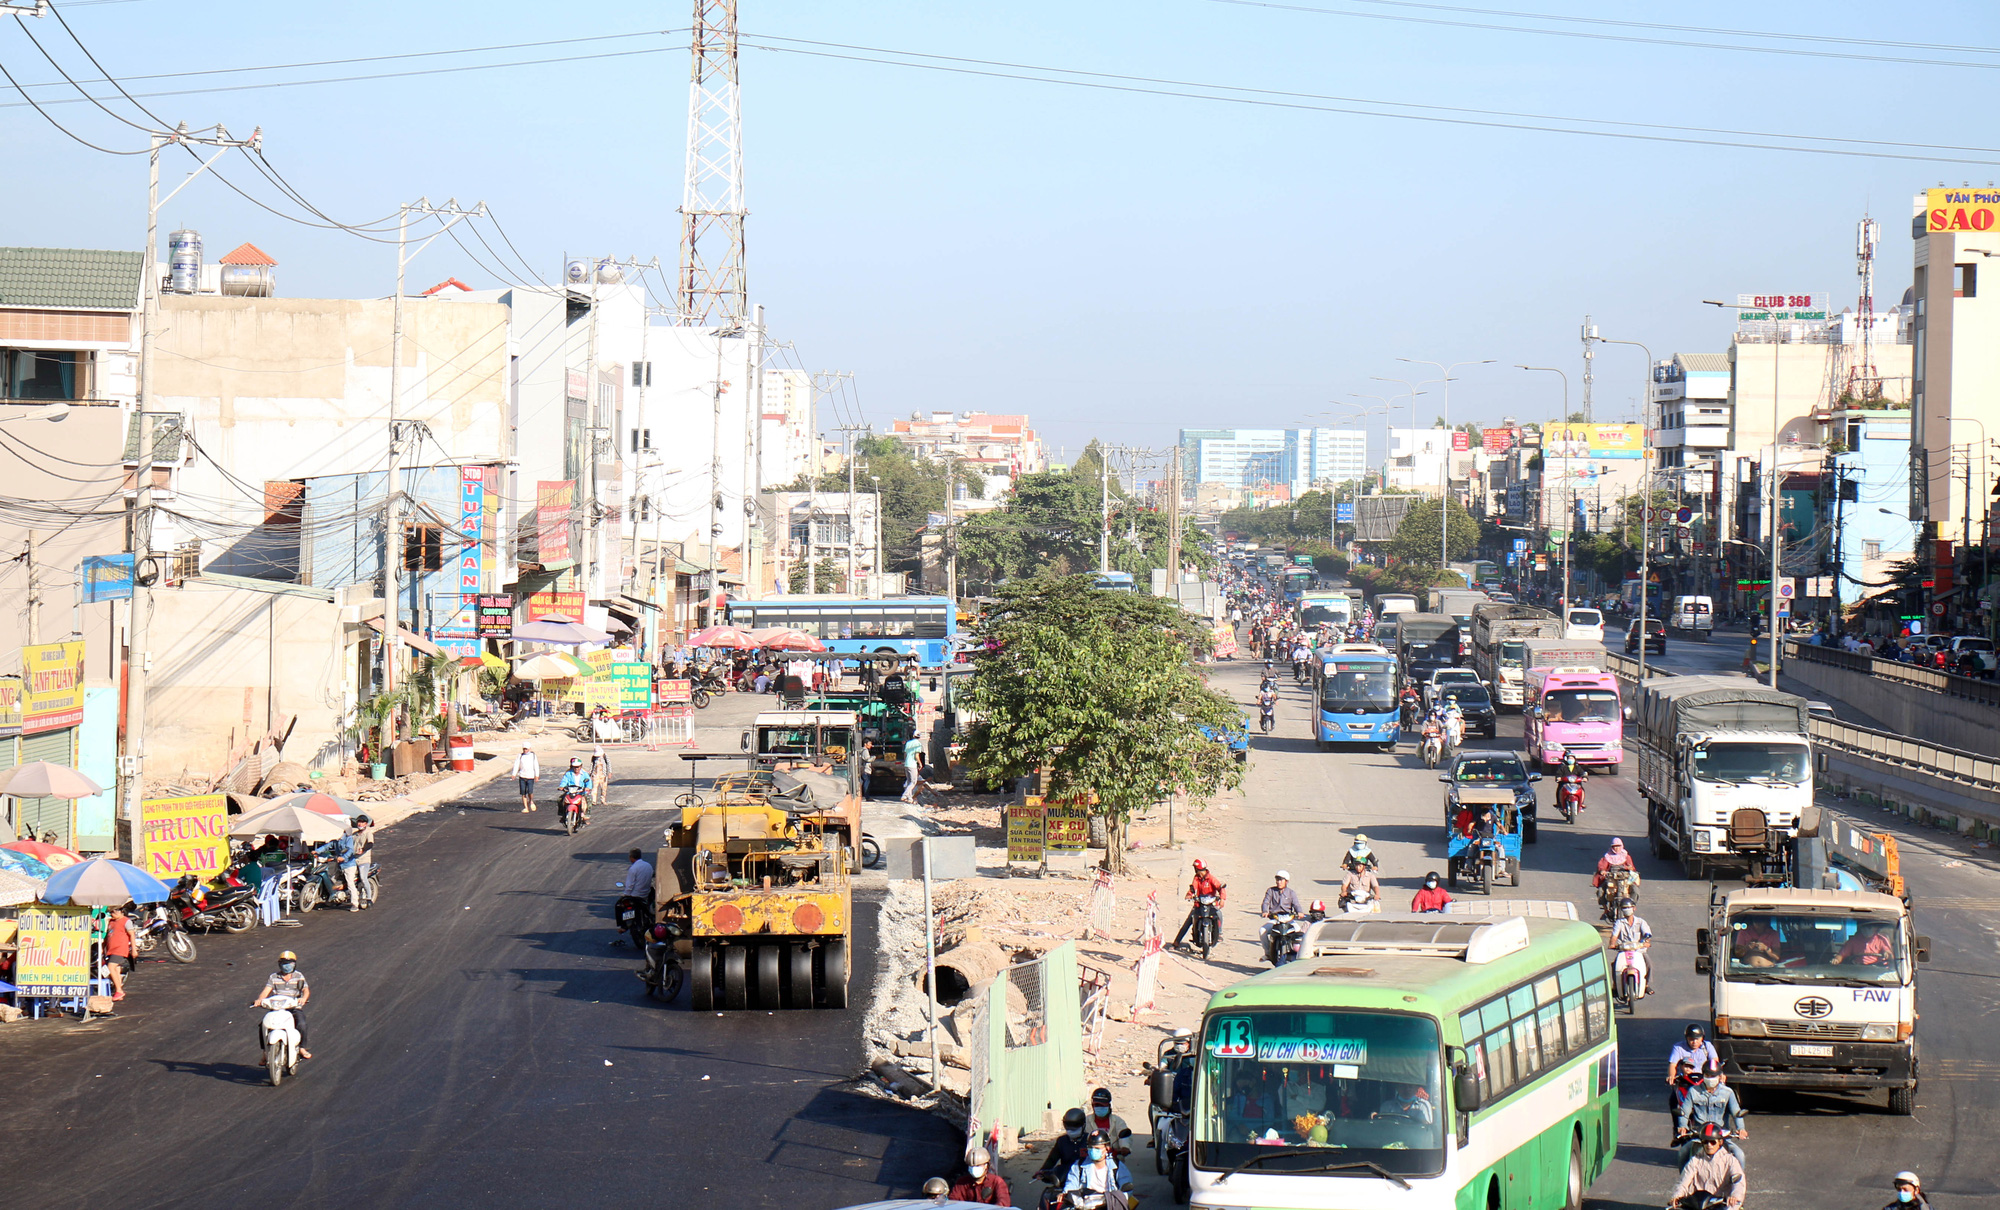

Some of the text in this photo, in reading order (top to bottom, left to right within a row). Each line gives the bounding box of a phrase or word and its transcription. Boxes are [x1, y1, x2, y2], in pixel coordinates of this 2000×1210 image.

[1945, 192, 1970, 203] VĂN
[1930, 208, 1995, 231] SAO
[1754, 295, 1811, 307] CLUB 368
[461, 557, 479, 605] ANH
[33, 659, 74, 693] ANH TUẤN
[677, 682, 689, 690] XE
[1009, 806, 1042, 818] HÙNG
[145, 813, 225, 843] TRUNG
[1048, 818, 1085, 831] XE CŨ
[152, 847, 218, 874] NAM
[20, 936, 86, 967] Thảo Linh
[31, 986, 50, 995] 0121
[51, 986, 66, 995] 861
[67, 986, 87, 995] 8707
[1853, 990, 1891, 1002] FAW
[1221, 1020, 1250, 1054] 13
[1276, 1042, 1299, 1059] CHI
[1301, 1042, 1319, 1058] 13
